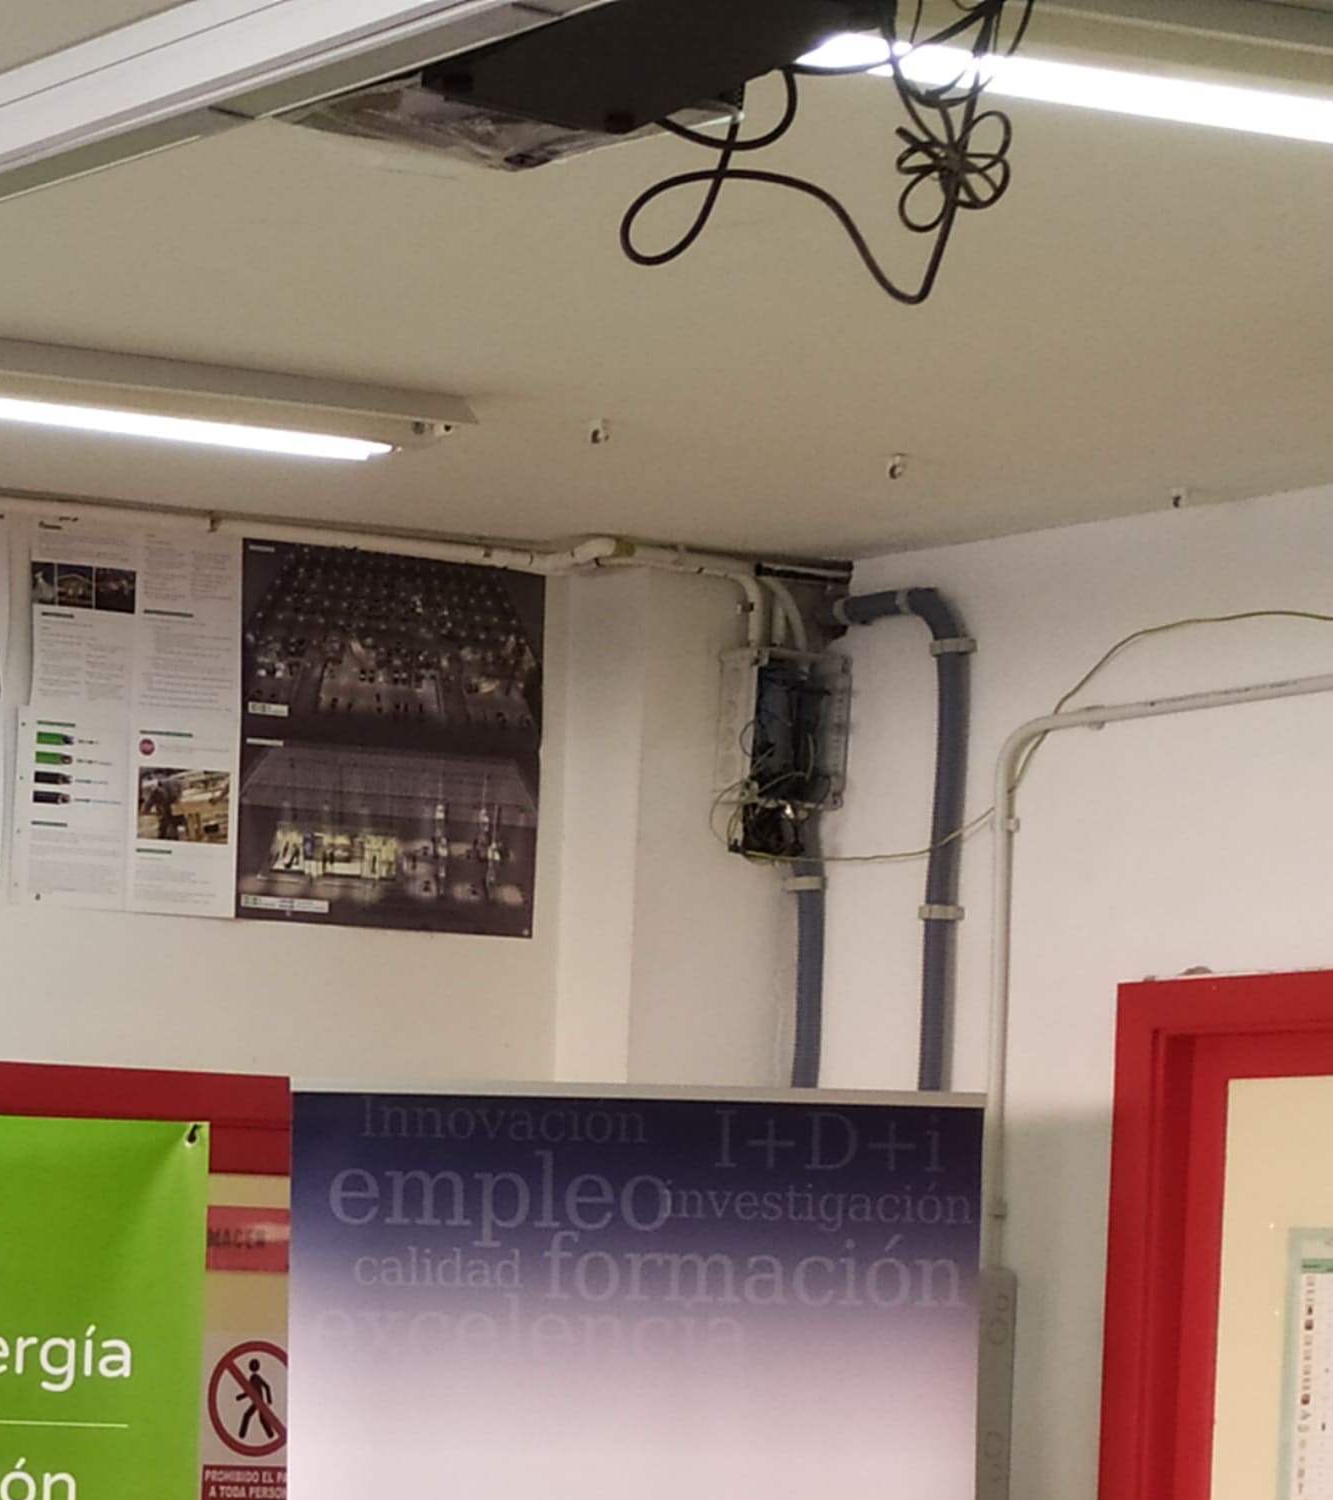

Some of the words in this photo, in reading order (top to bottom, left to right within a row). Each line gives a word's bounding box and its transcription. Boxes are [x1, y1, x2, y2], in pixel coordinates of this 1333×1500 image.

[362, 1097, 647, 1144] Innovación
[714, 1109, 944, 1173] I+D+i
[330, 1150, 673, 1248] empleo
[663, 1180, 973, 1231] investigación
[354, 1246, 523, 1290] calidad
[543, 1226, 968, 1308] formación
[205, 1470, 259, 1483] PROHIBIDO
[262, 1471, 274, 1484] EL
[209, 1486, 217, 1498] A
[219, 1486, 246, 1498] TODA
